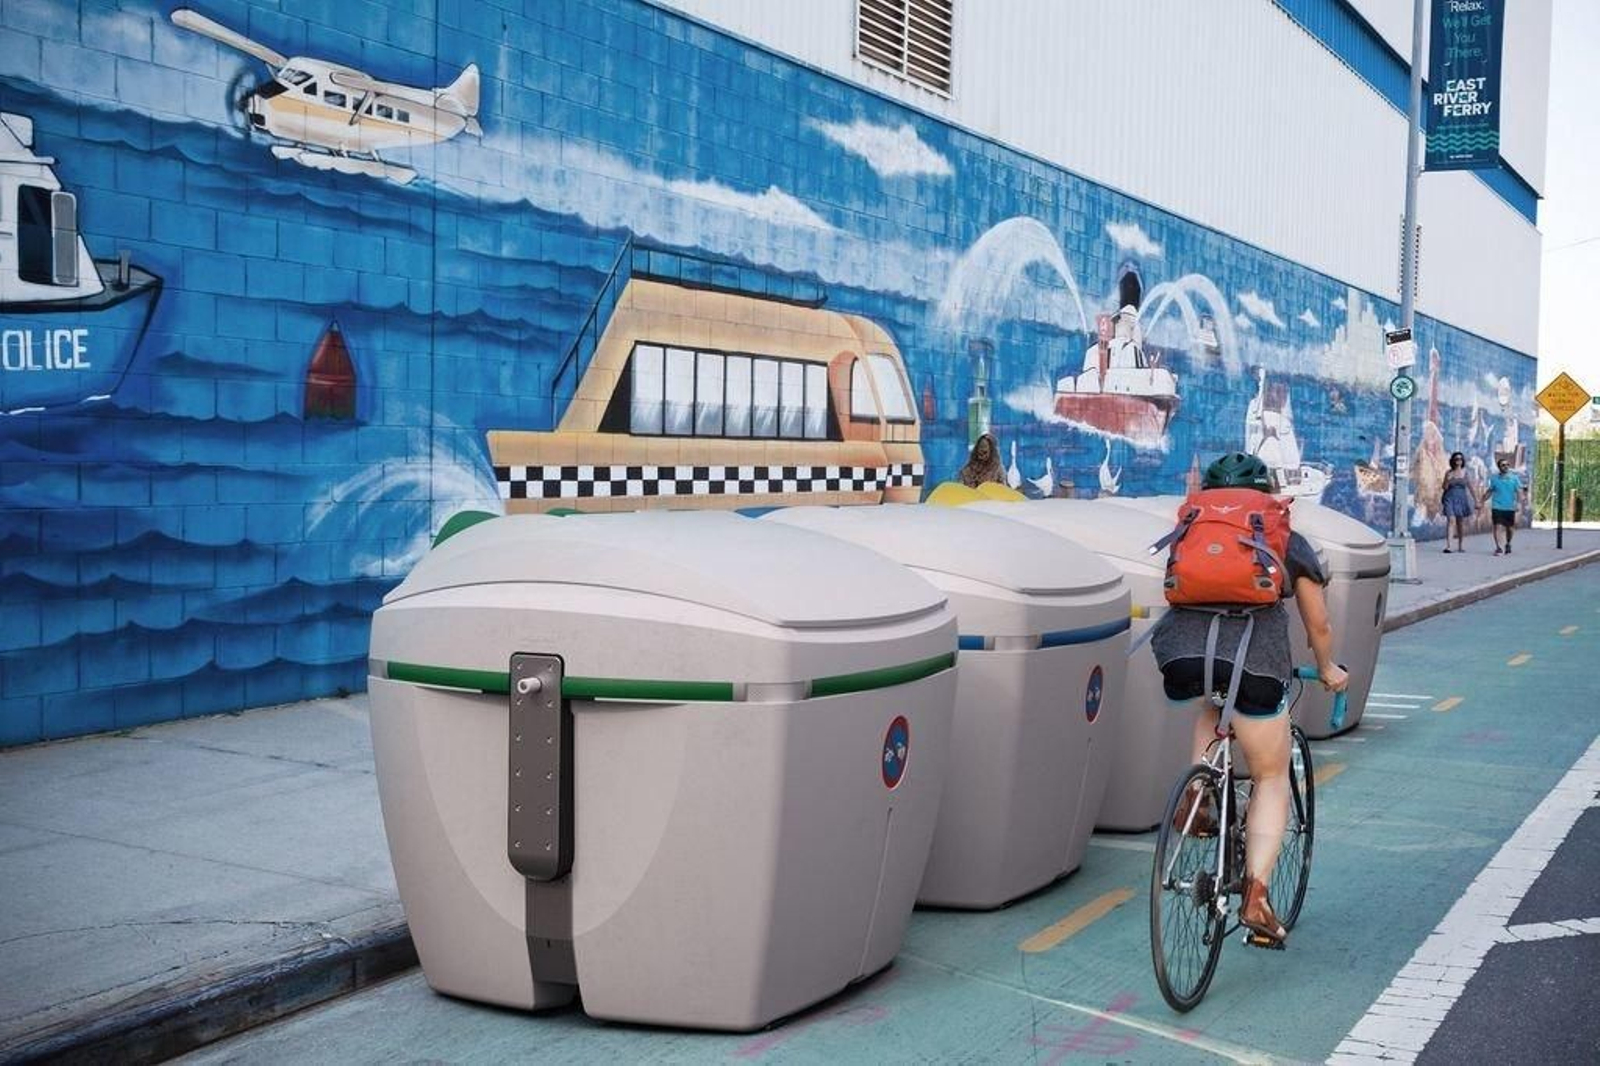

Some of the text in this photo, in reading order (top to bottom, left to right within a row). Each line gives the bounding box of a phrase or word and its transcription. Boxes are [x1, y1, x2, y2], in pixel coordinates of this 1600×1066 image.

[1450, 0, 1485, 12] Relax.
[1454, 31, 1476, 44] You
[1446, 77, 1487, 92] EAST
[1433, 91, 1478, 106] RIVER
[1443, 101, 1492, 117] FERRY
